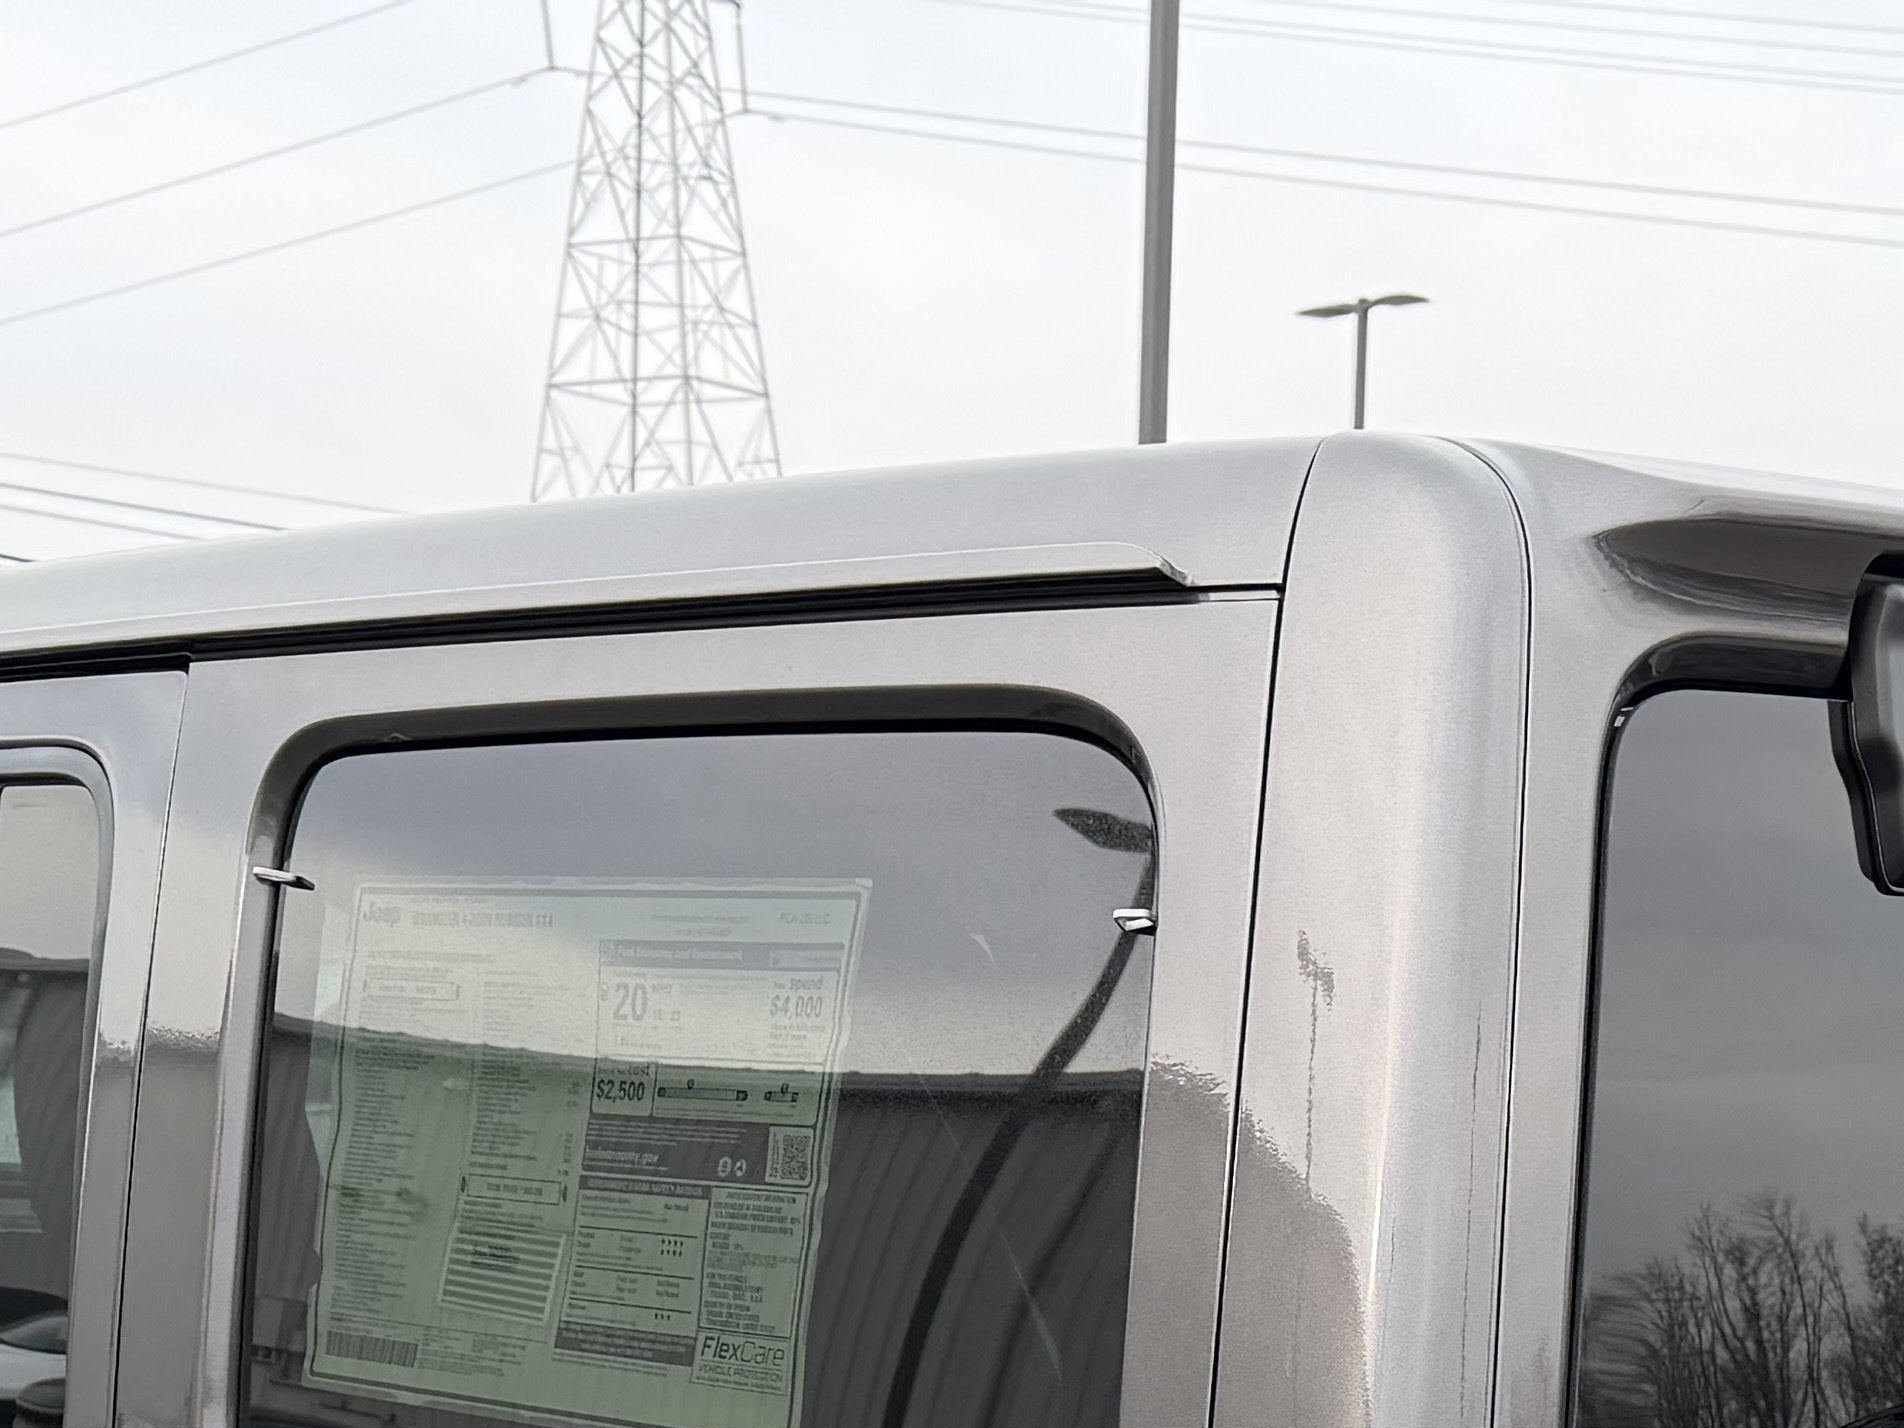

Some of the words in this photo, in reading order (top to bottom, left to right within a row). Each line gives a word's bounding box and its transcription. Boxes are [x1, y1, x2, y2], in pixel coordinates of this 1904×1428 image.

[612, 981, 649, 1022] 20
[769, 993, 823, 1020] $4,000
[596, 1078, 646, 1103] $2,500
[700, 1335, 785, 1367] FlexCare
